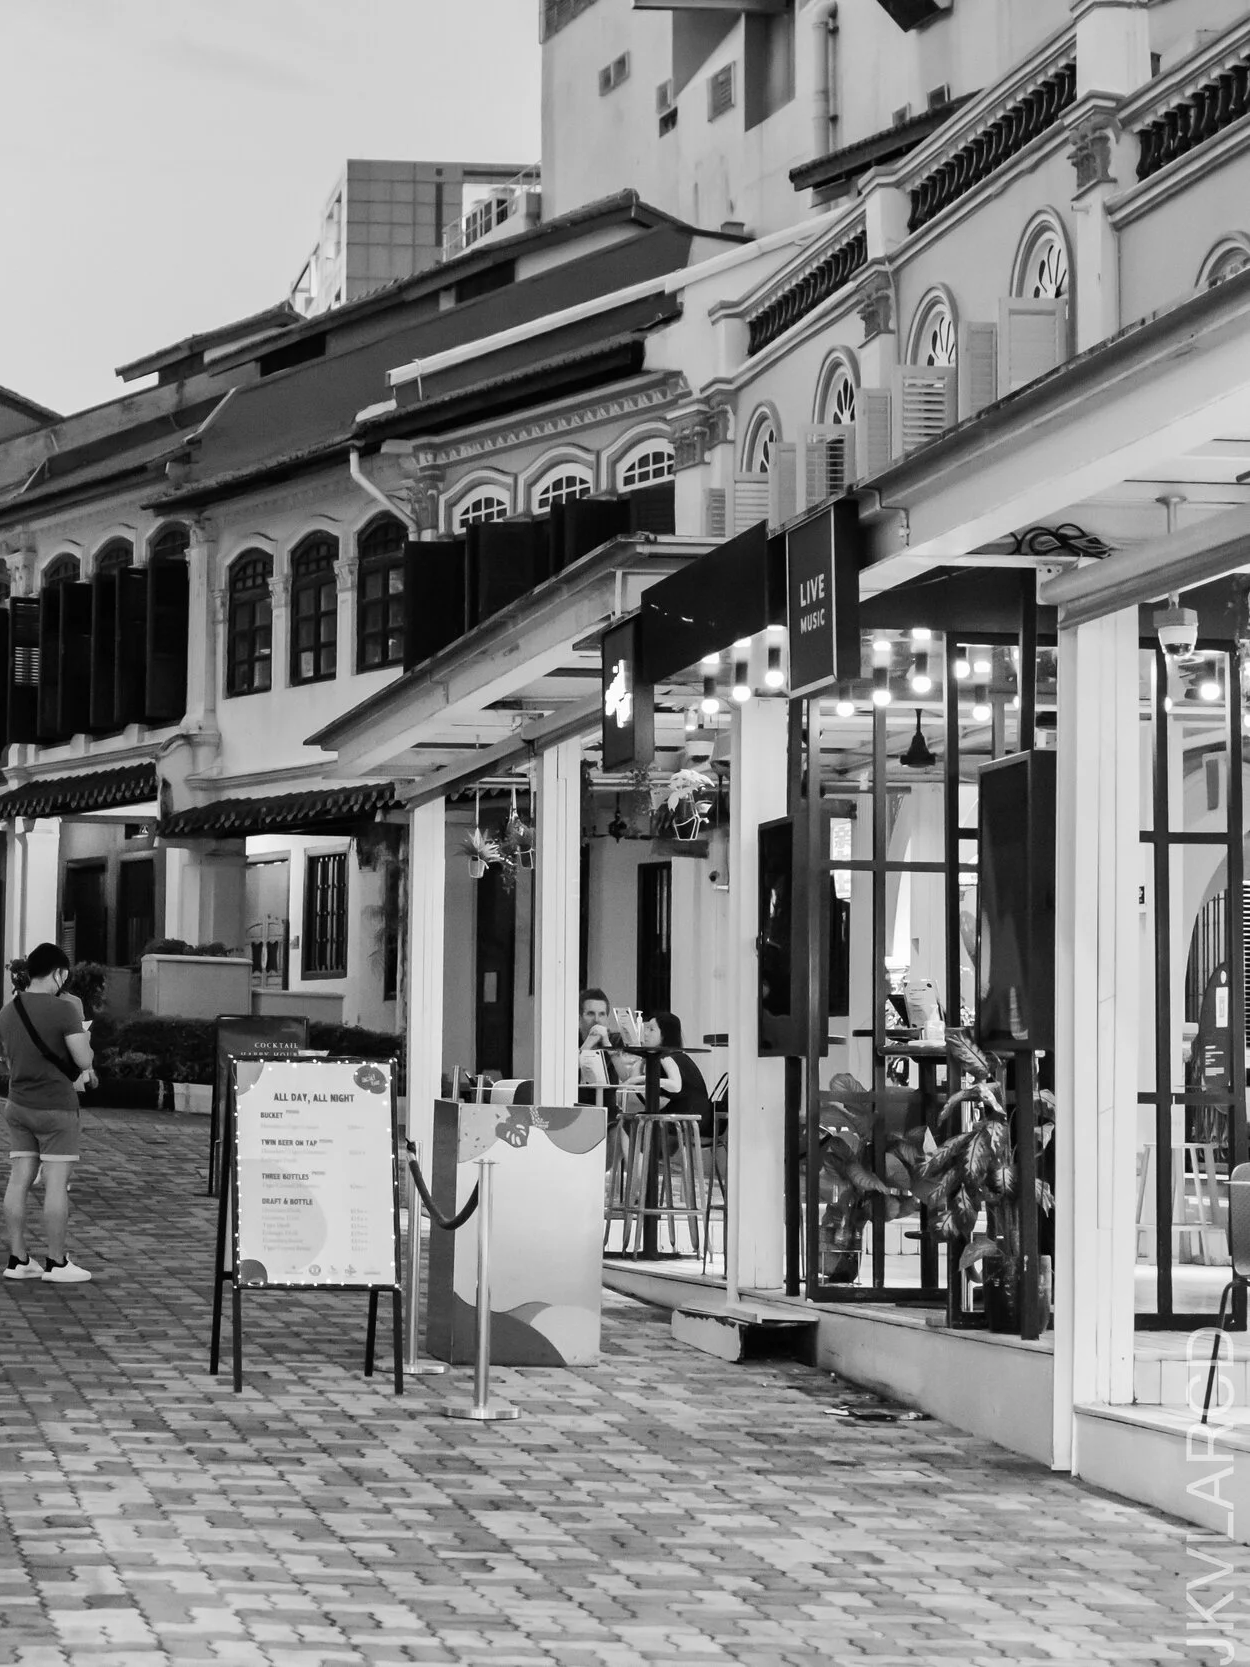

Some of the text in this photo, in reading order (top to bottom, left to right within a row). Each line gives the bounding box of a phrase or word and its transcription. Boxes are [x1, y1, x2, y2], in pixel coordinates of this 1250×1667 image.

[800, 573, 825, 607] LIVE
[800, 608, 825, 635] MUSIC
[273, 1093, 355, 1104] ALL DAY, ALL NIGHT
[260, 1111, 283, 1119] BUCKET
[290, 1198, 313, 1206] BOTTLE
